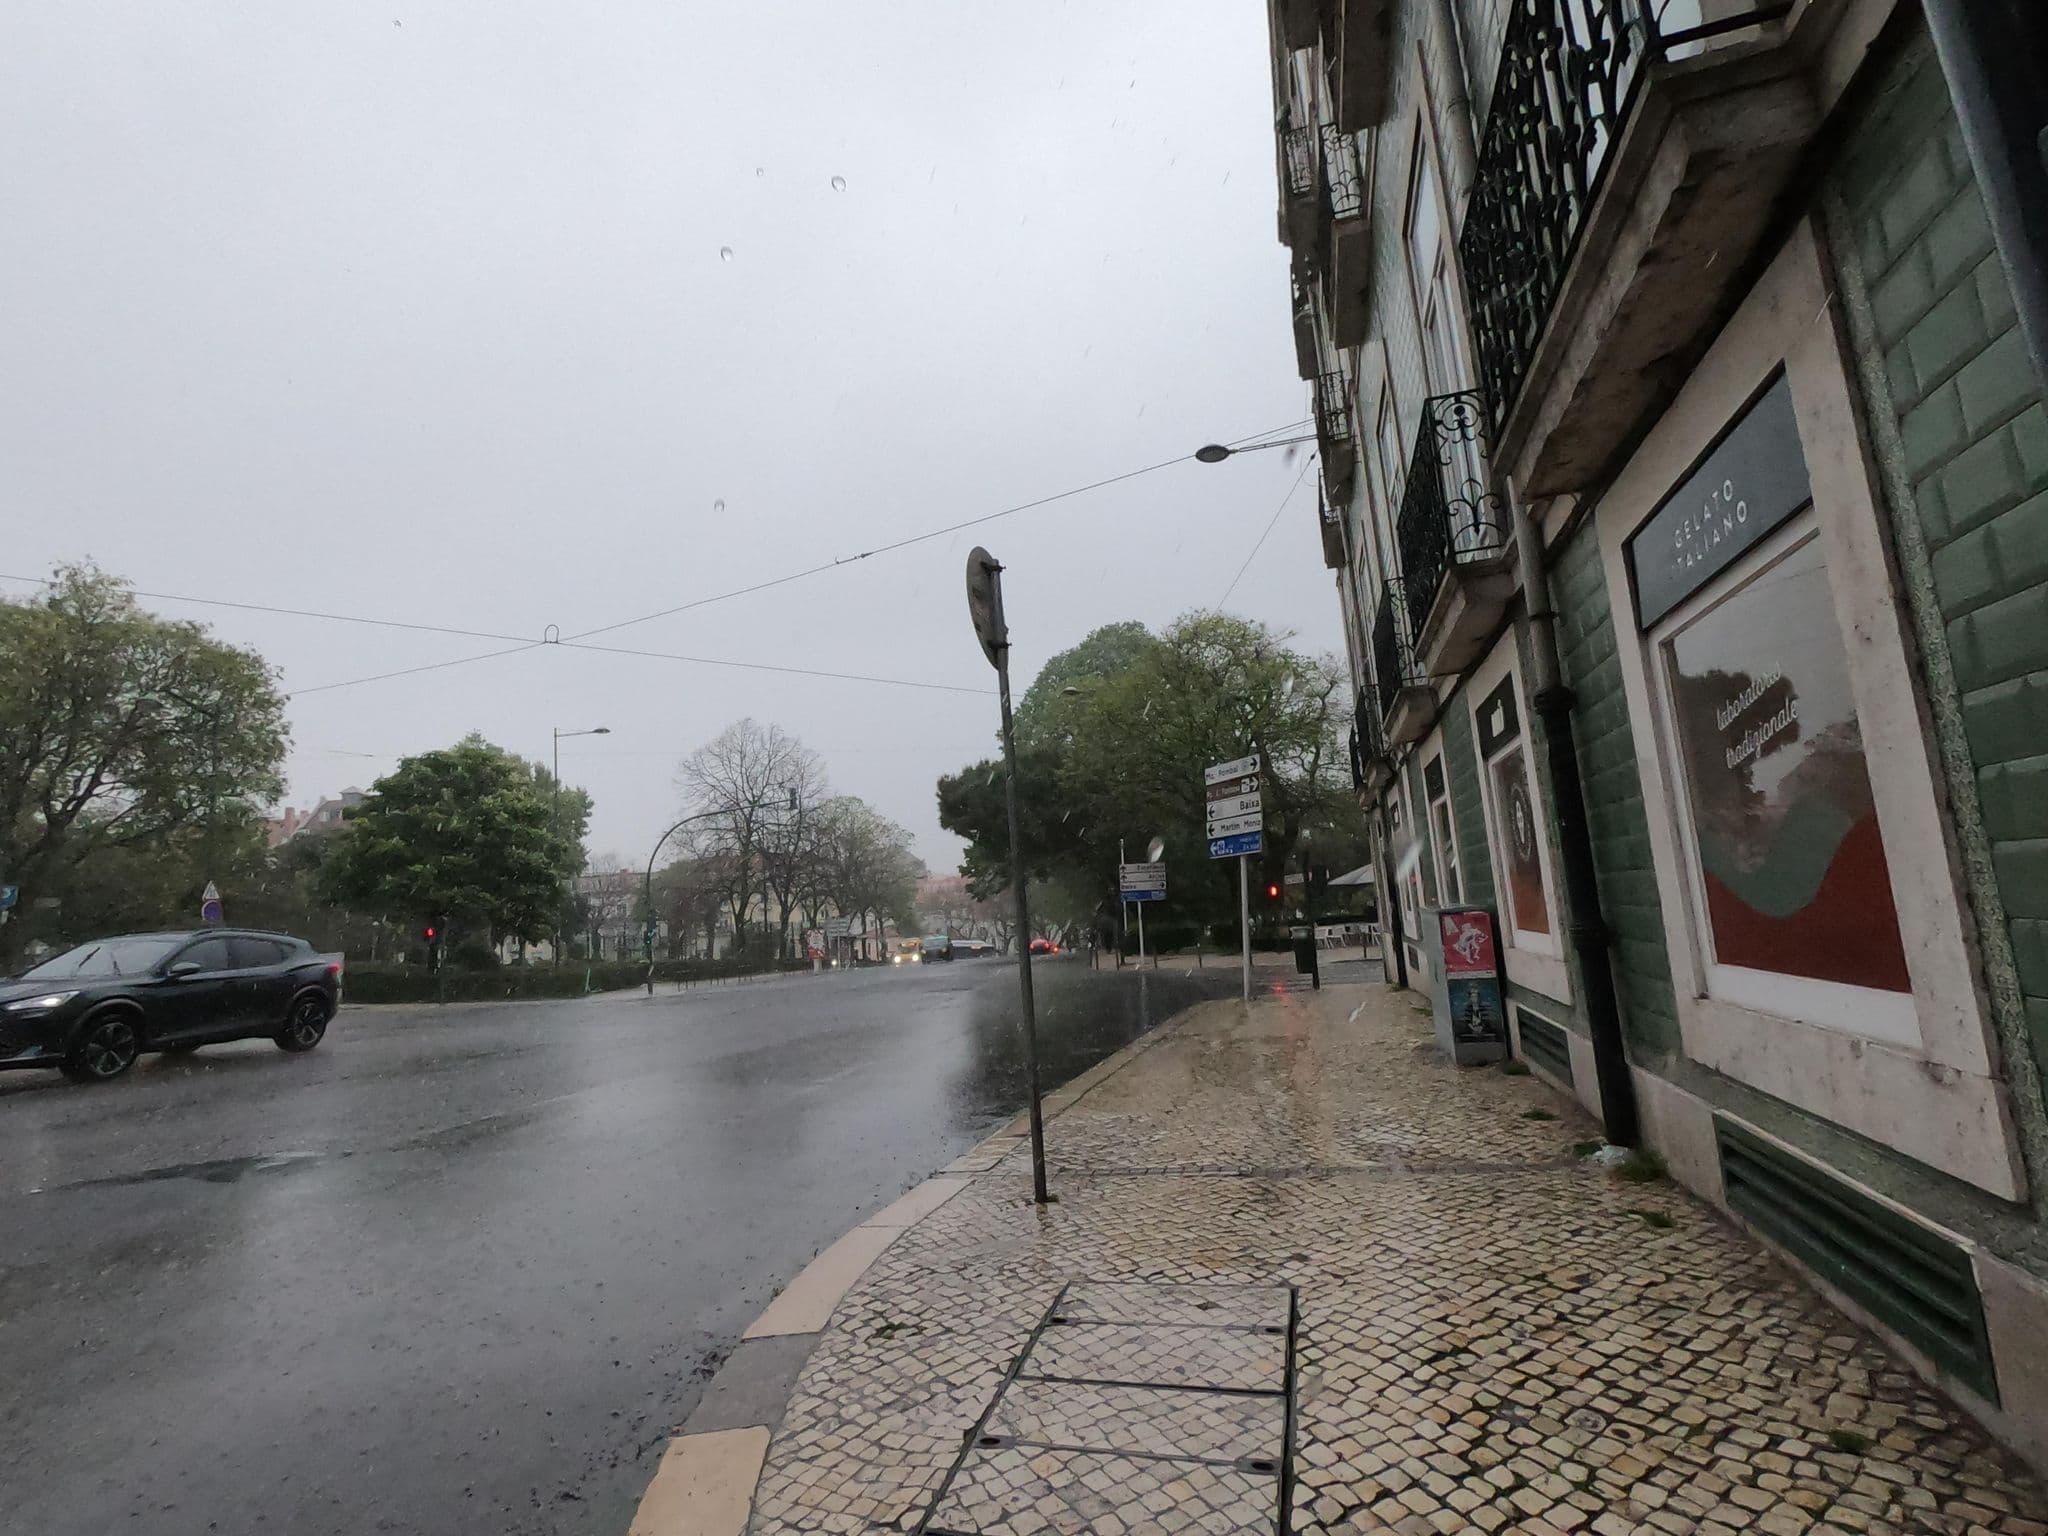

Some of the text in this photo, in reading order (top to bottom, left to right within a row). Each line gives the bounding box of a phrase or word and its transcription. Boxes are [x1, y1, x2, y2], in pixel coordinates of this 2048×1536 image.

[1675, 479, 1733, 548] GELATO
[1672, 500, 1747, 570] TALIANO
[1221, 819, 1261, 832] Martim Moniz
[1240, 800, 1260, 811] Baixa
